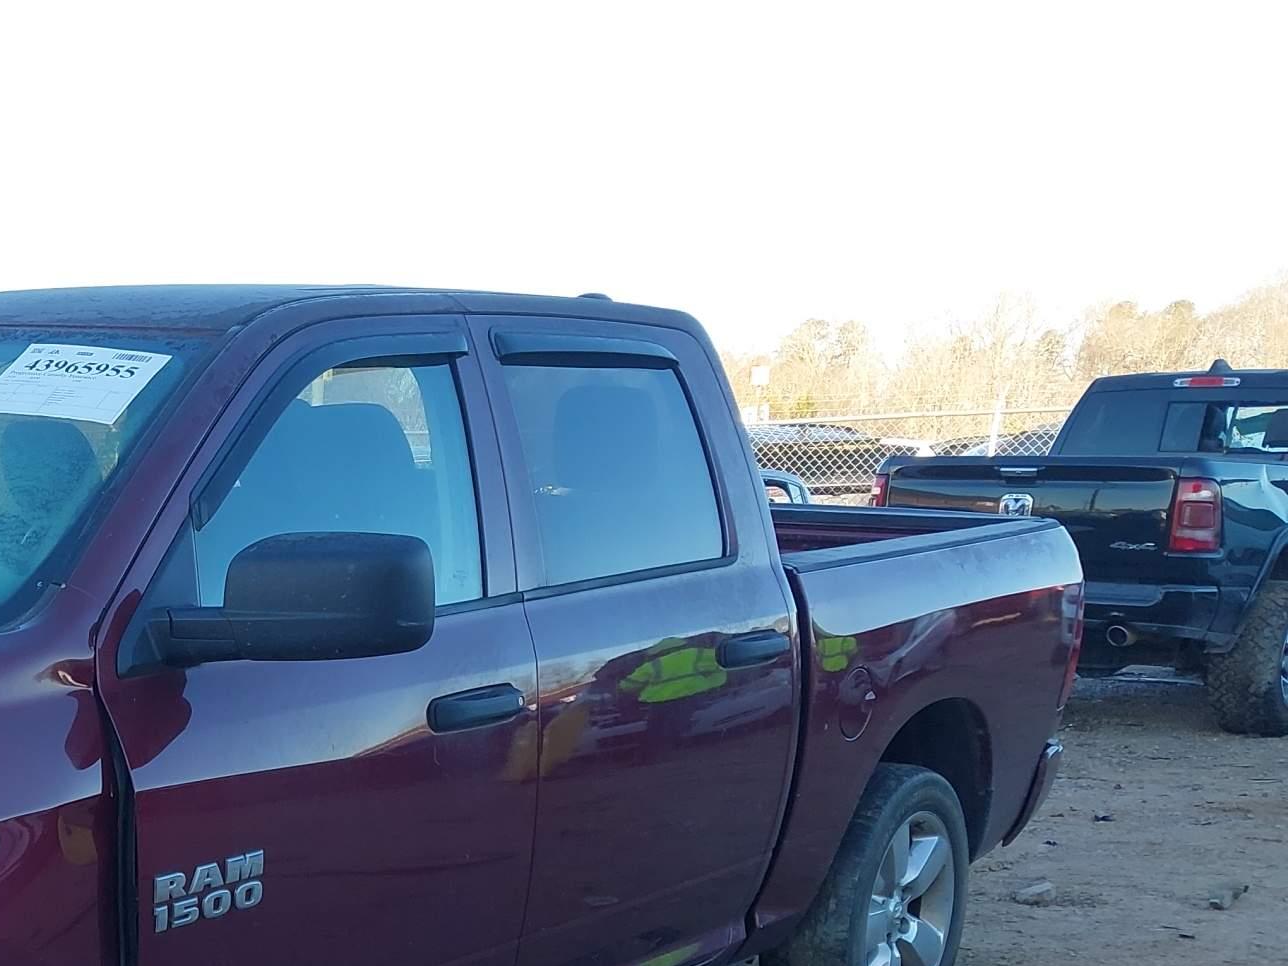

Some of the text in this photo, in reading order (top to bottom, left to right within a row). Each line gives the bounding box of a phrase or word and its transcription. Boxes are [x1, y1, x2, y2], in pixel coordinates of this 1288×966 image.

[24, 358, 140, 378] 43965955
[154, 849, 264, 904] RAM
[154, 880, 264, 933] 1500
